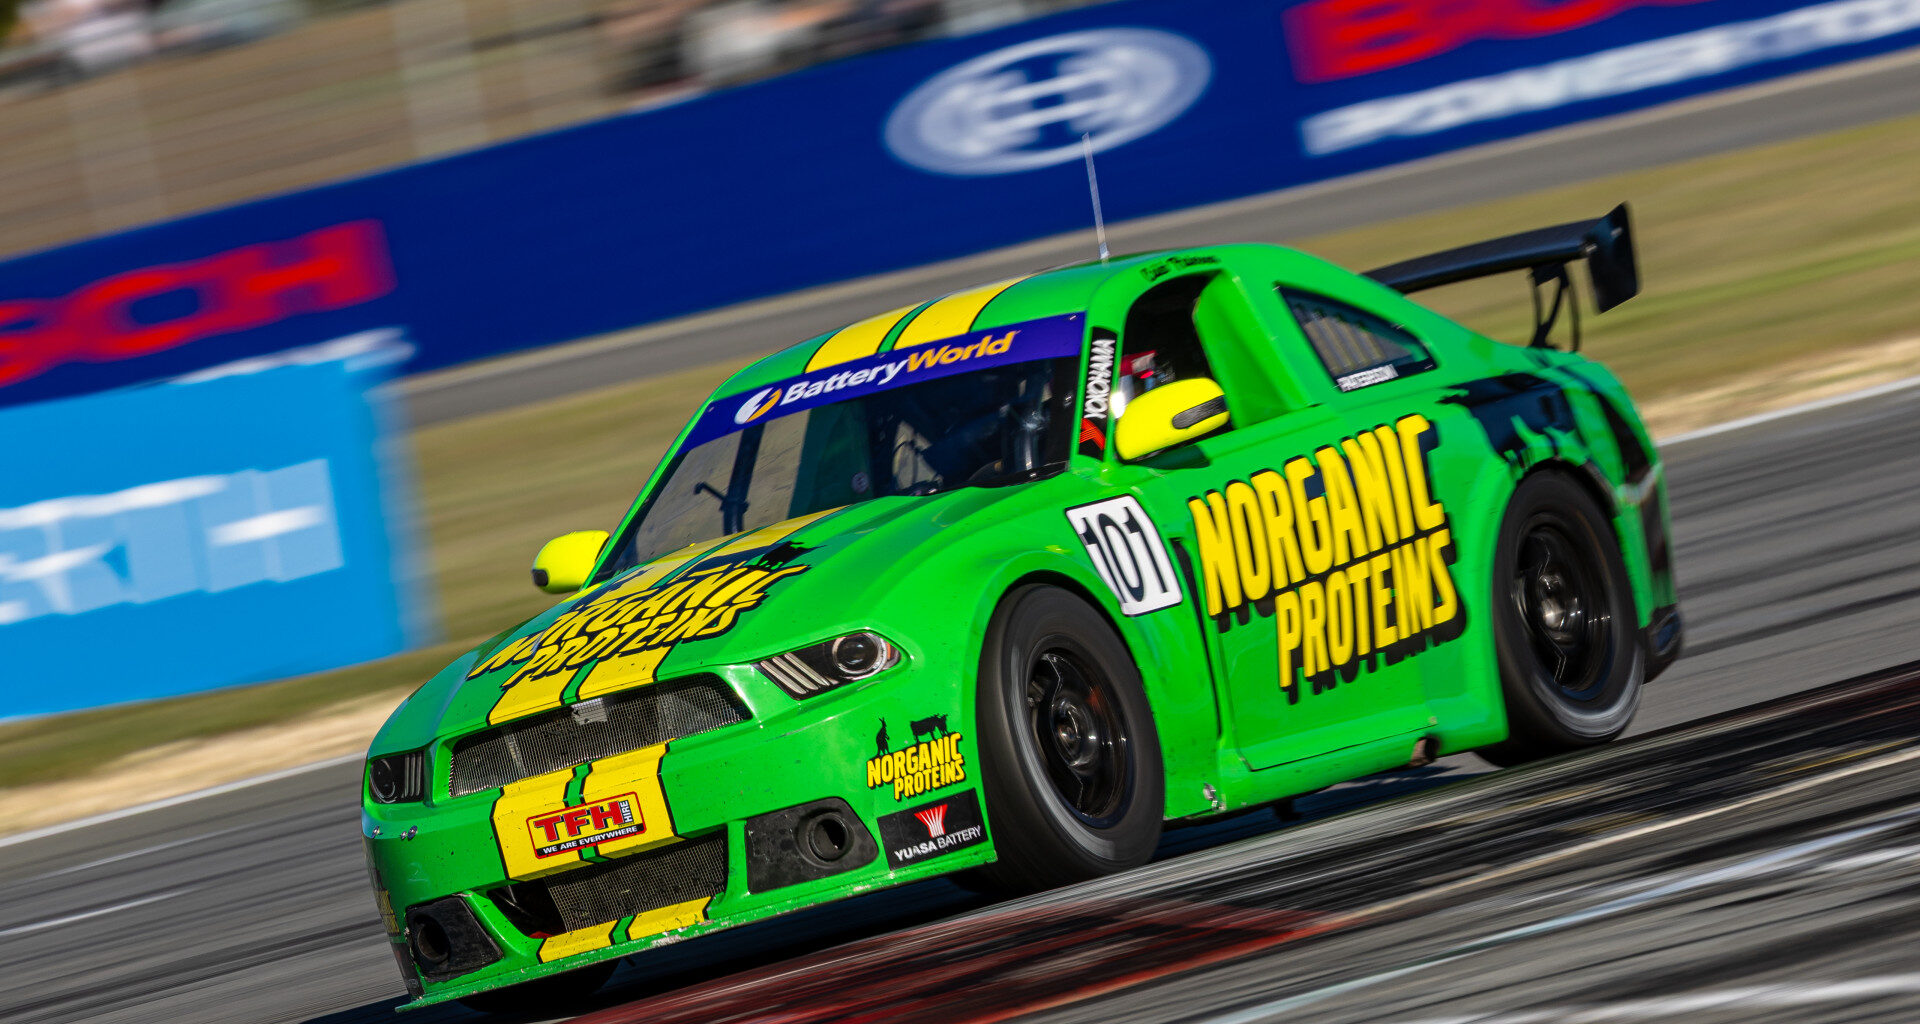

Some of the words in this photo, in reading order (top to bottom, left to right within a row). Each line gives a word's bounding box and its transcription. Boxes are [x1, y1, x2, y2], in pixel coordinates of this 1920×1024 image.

[1084, 339, 1115, 419] YOKOHAMA
[1188, 414, 1446, 618] NORGANIC
[1080, 506, 1168, 603] 101
[466, 561, 810, 681] NORGANIC
[1275, 528, 1460, 688] PROTEINS
[502, 600, 759, 690] PROTEINS
[866, 732, 962, 788] NORGANIC
[894, 758, 966, 801] PROTEINS
[533, 801, 625, 842] TFH
[543, 846, 558, 855] WE
[560, 841, 578, 850] ARE
[580, 825, 638, 845] EVERYWHERE
[620, 800, 633, 823] HIRE
[894, 840, 937, 861] YUASA
[937, 825, 981, 849] BATTERY
